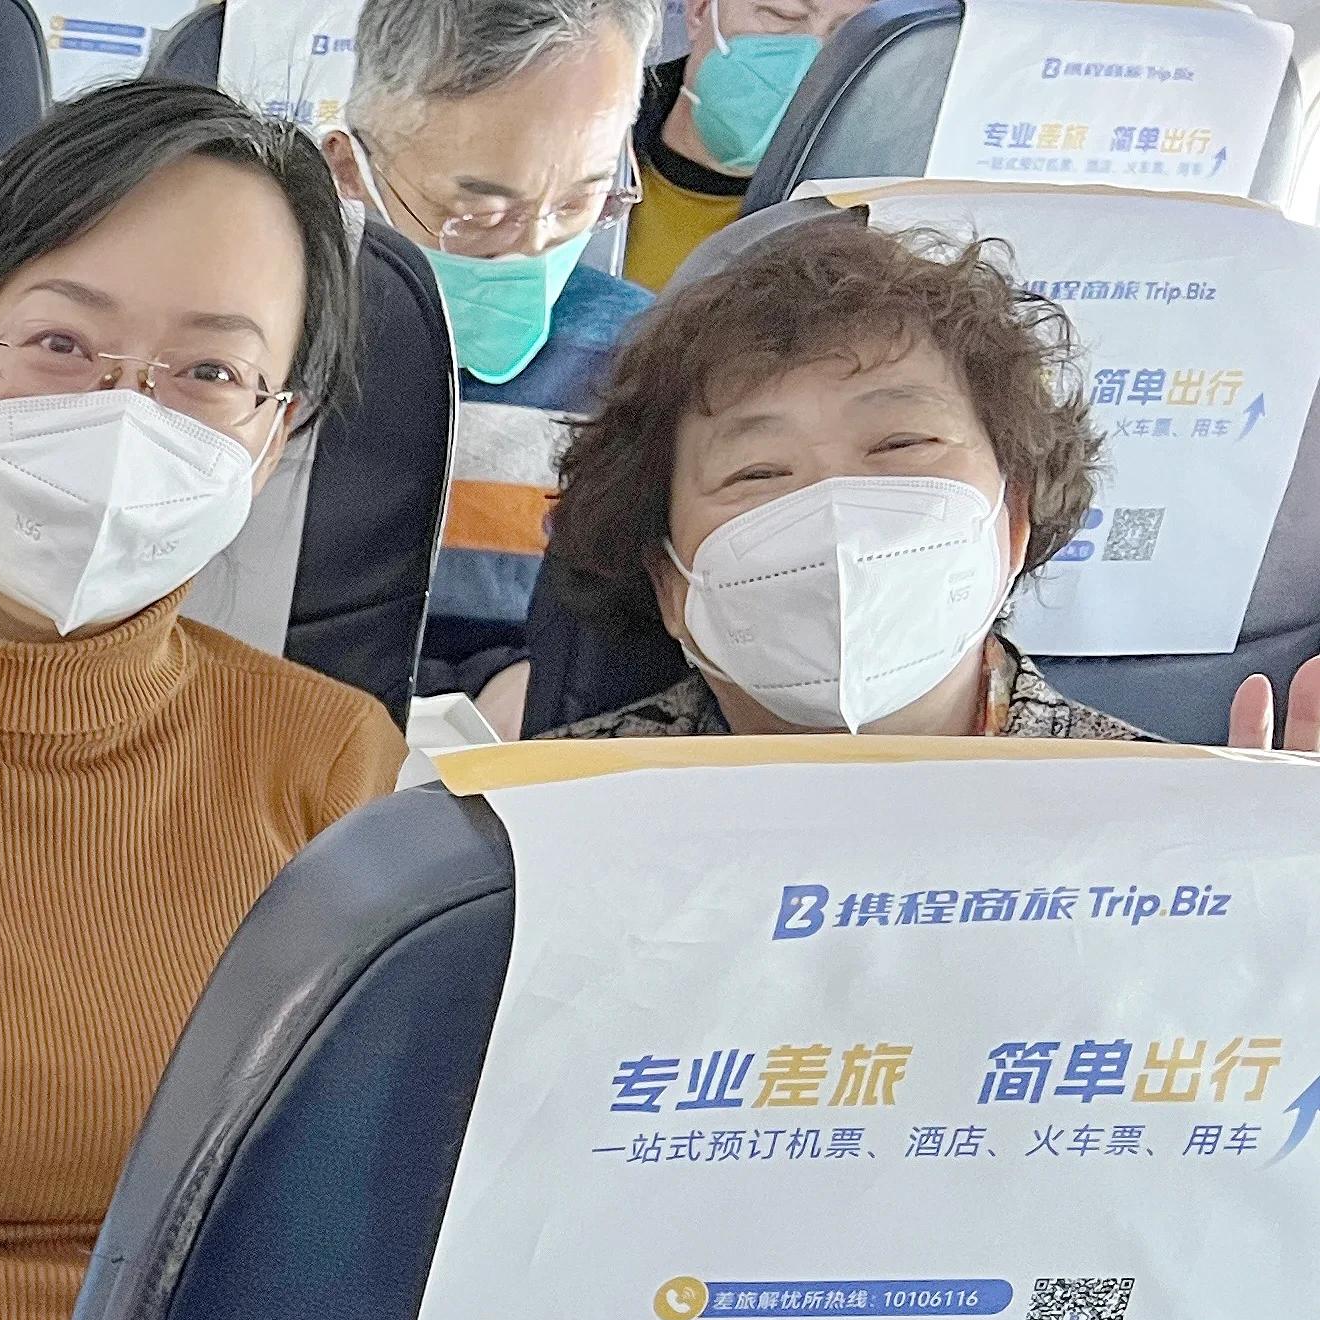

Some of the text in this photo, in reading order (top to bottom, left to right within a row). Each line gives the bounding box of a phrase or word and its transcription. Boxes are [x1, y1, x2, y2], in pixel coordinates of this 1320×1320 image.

[1145, 282, 1217, 305] Trip.Biz
[1089, 368, 1245, 406] 简单出行
[833, 887, 1081, 927] 携程商旅
[1088, 884, 1233, 925] Trip.Biz
[610, 1037, 1282, 1113] 专业差旅 简单出行
